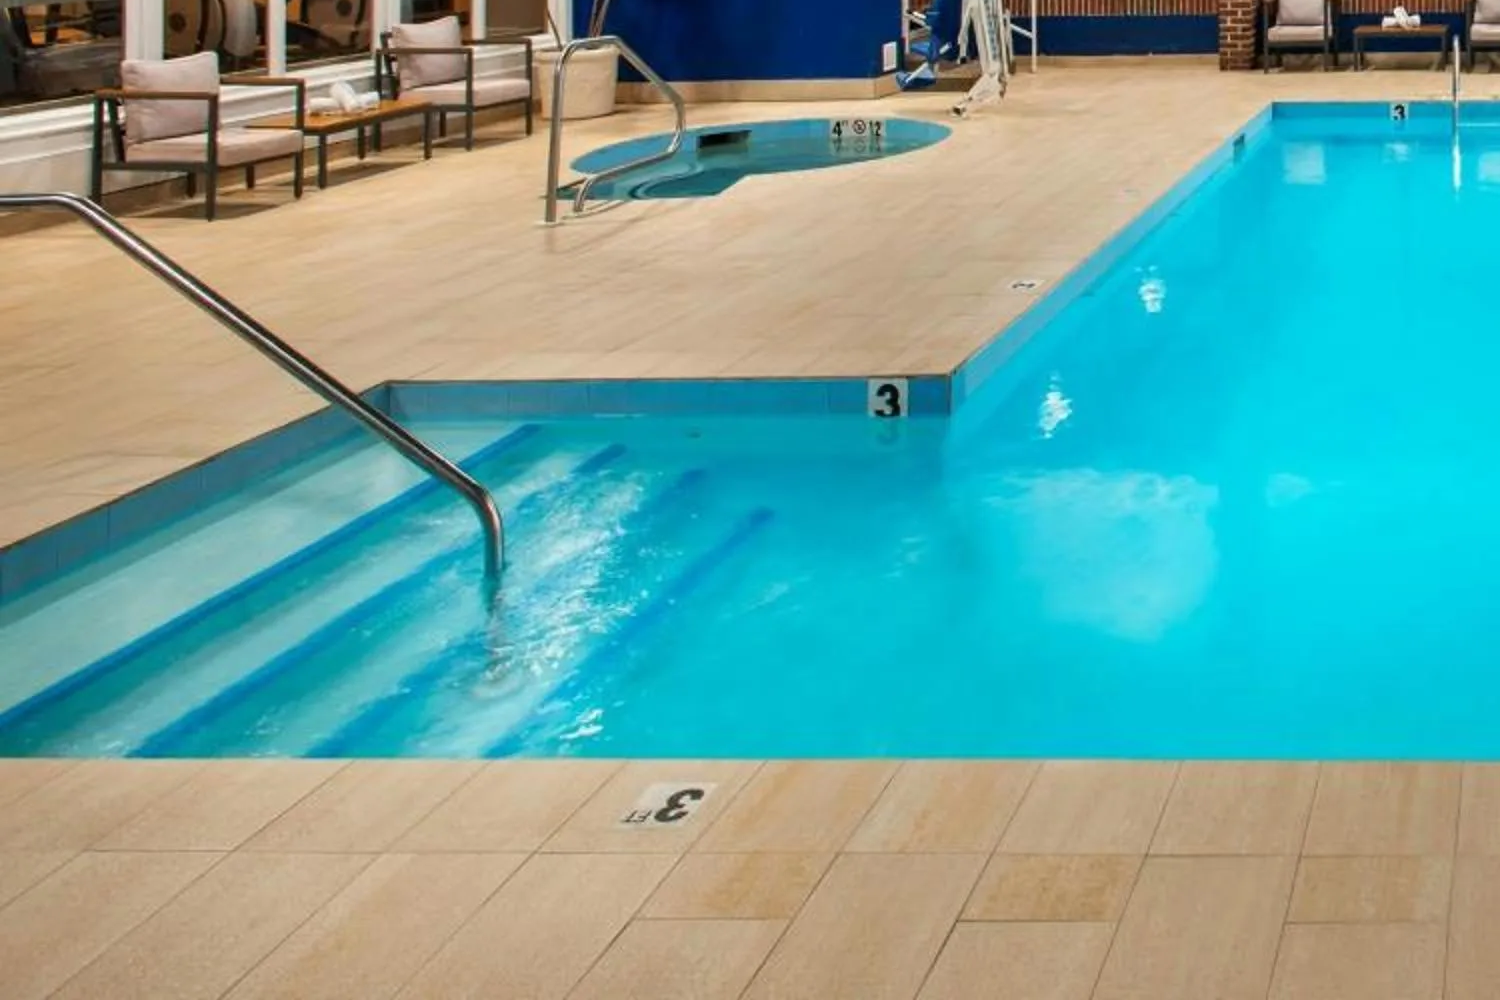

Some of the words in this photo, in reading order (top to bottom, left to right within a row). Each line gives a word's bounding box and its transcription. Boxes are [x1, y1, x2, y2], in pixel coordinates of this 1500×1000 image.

[1394, 103, 1405, 120] 3
[832, 120, 843, 136] 4
[874, 383, 901, 418] 3
[654, 788, 705, 823] 3
